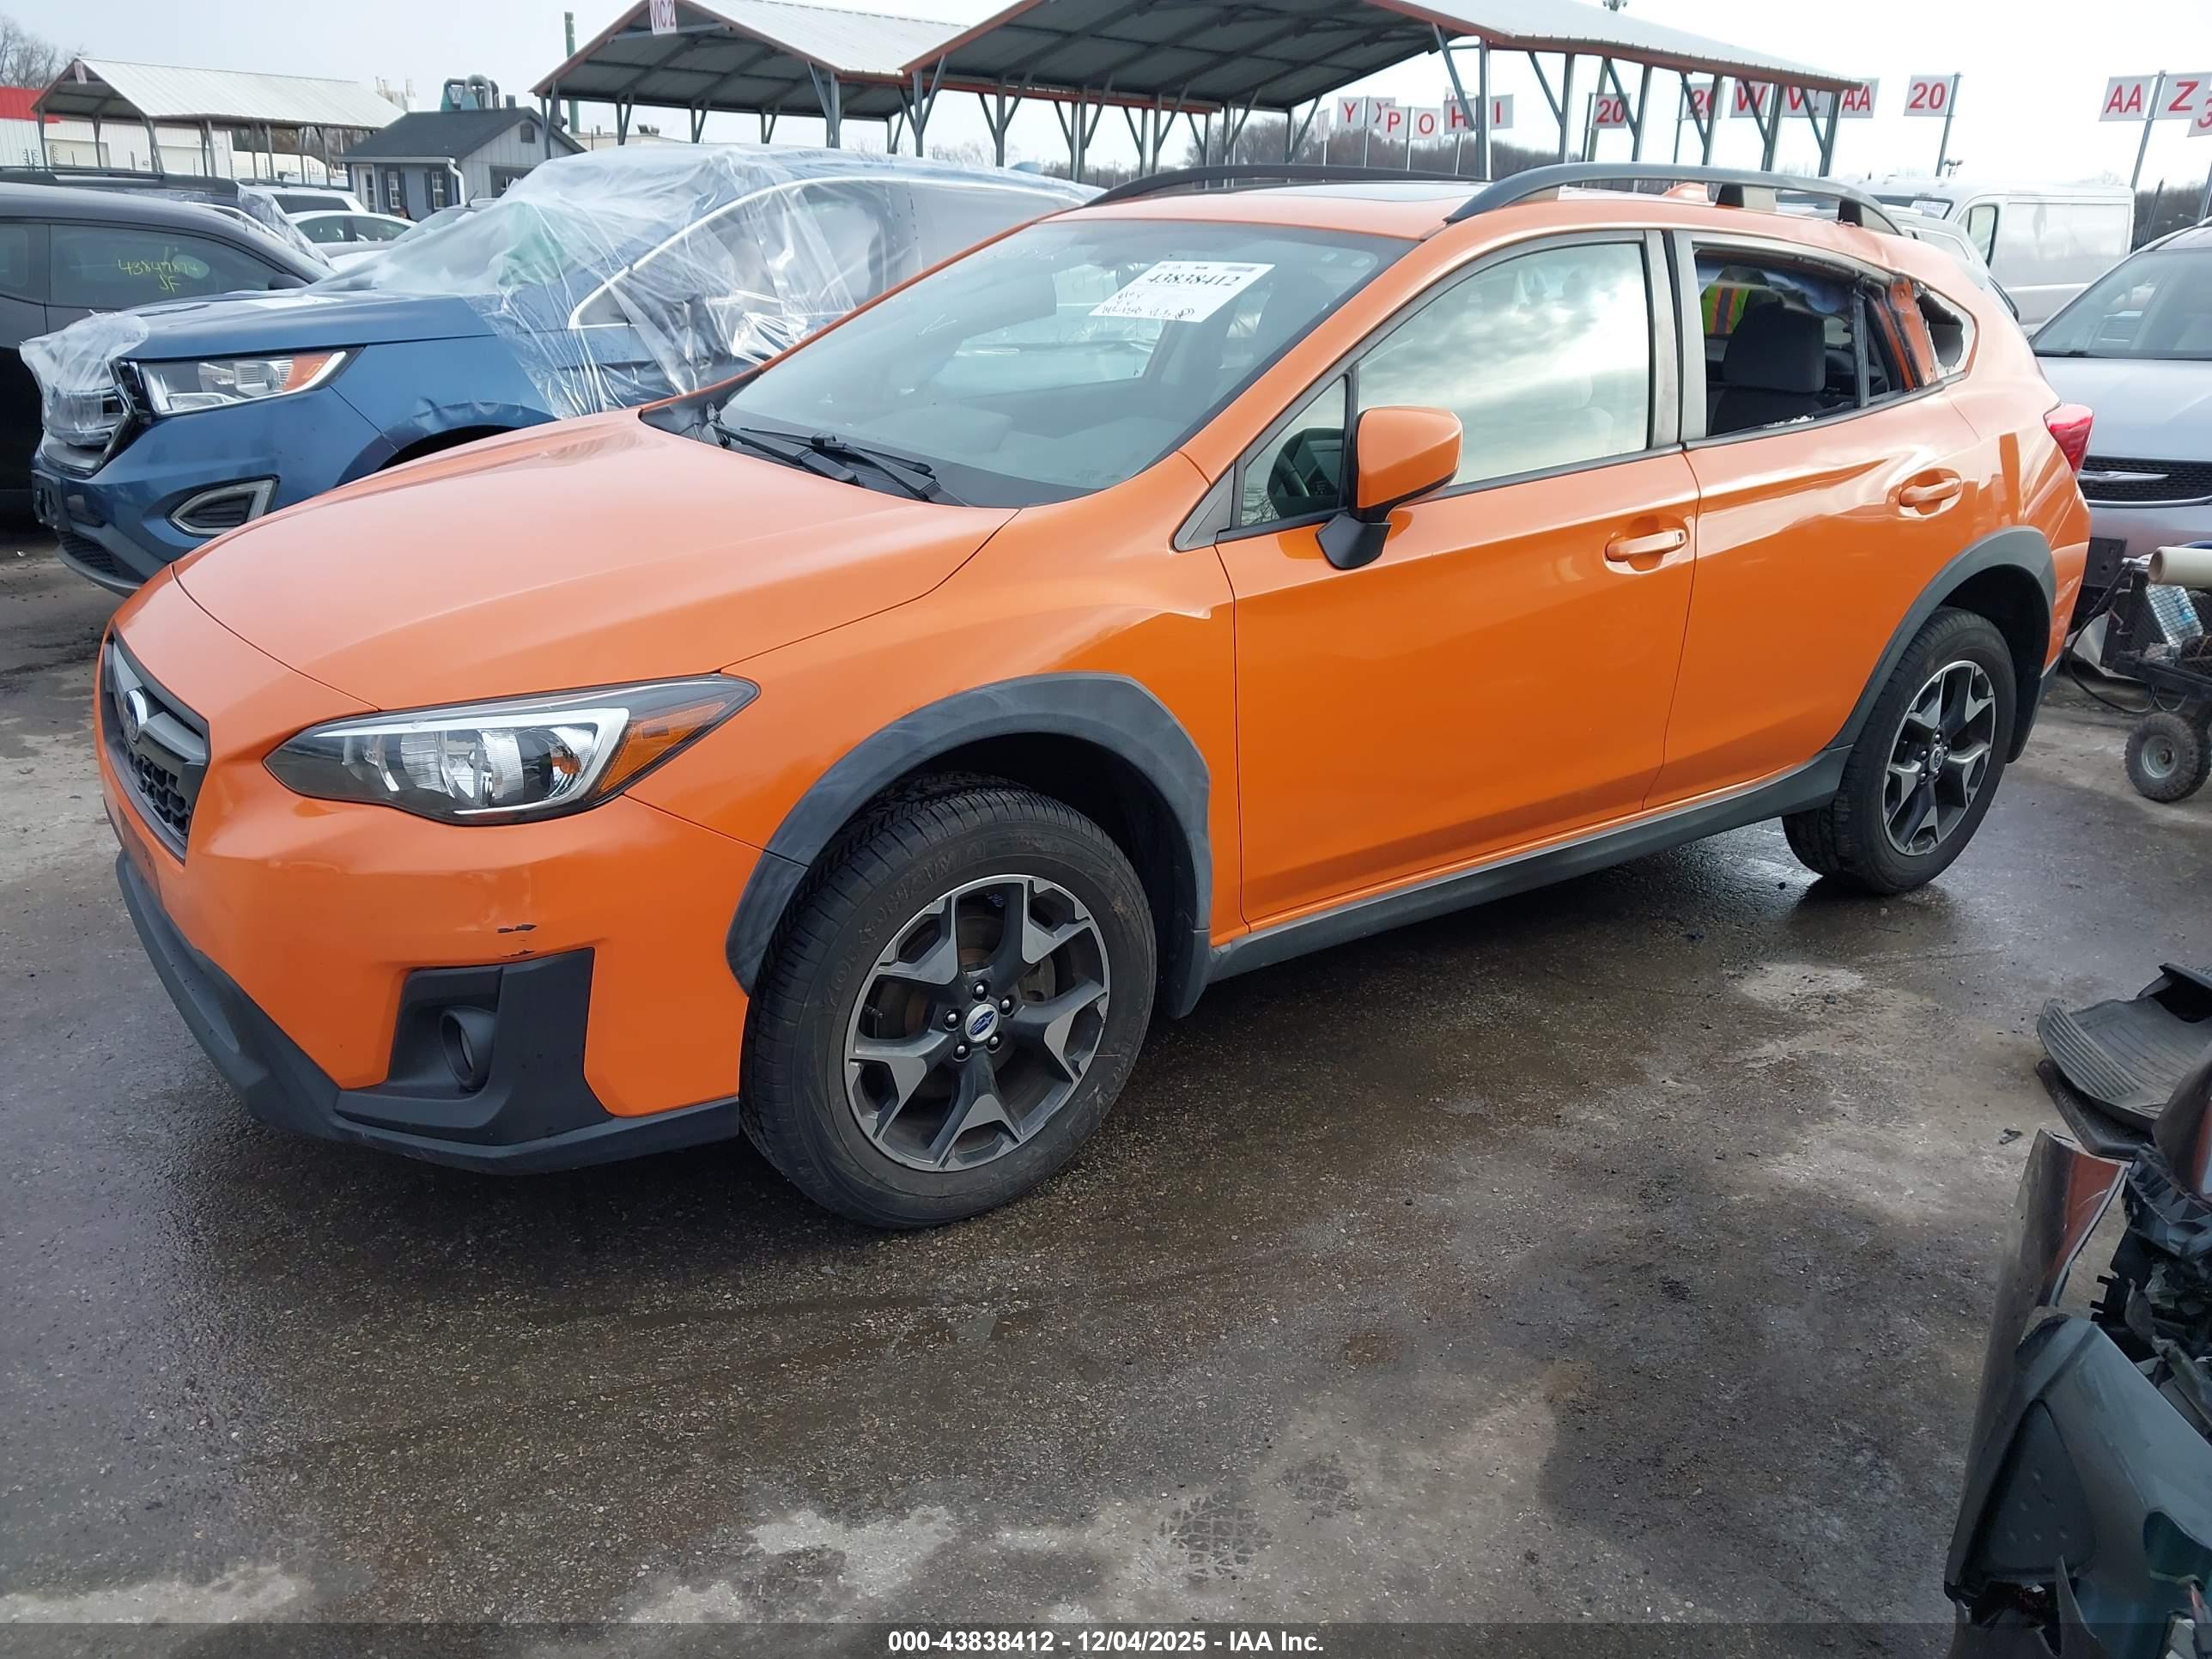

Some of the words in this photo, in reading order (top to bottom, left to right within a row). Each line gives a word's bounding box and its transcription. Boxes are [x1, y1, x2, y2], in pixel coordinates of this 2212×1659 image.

[667, 0, 675, 27] 2
[1842, 85, 1871, 111] AA
[1909, 82, 1946, 109] 20
[2106, 83, 2141, 113] AA
[2168, 81, 2199, 111] Z
[1343, 102, 1357, 123] Y
[1387, 112, 1401, 133] P
[1596, 99, 1625, 123] 20
[1147, 273, 1241, 286] 43838412
